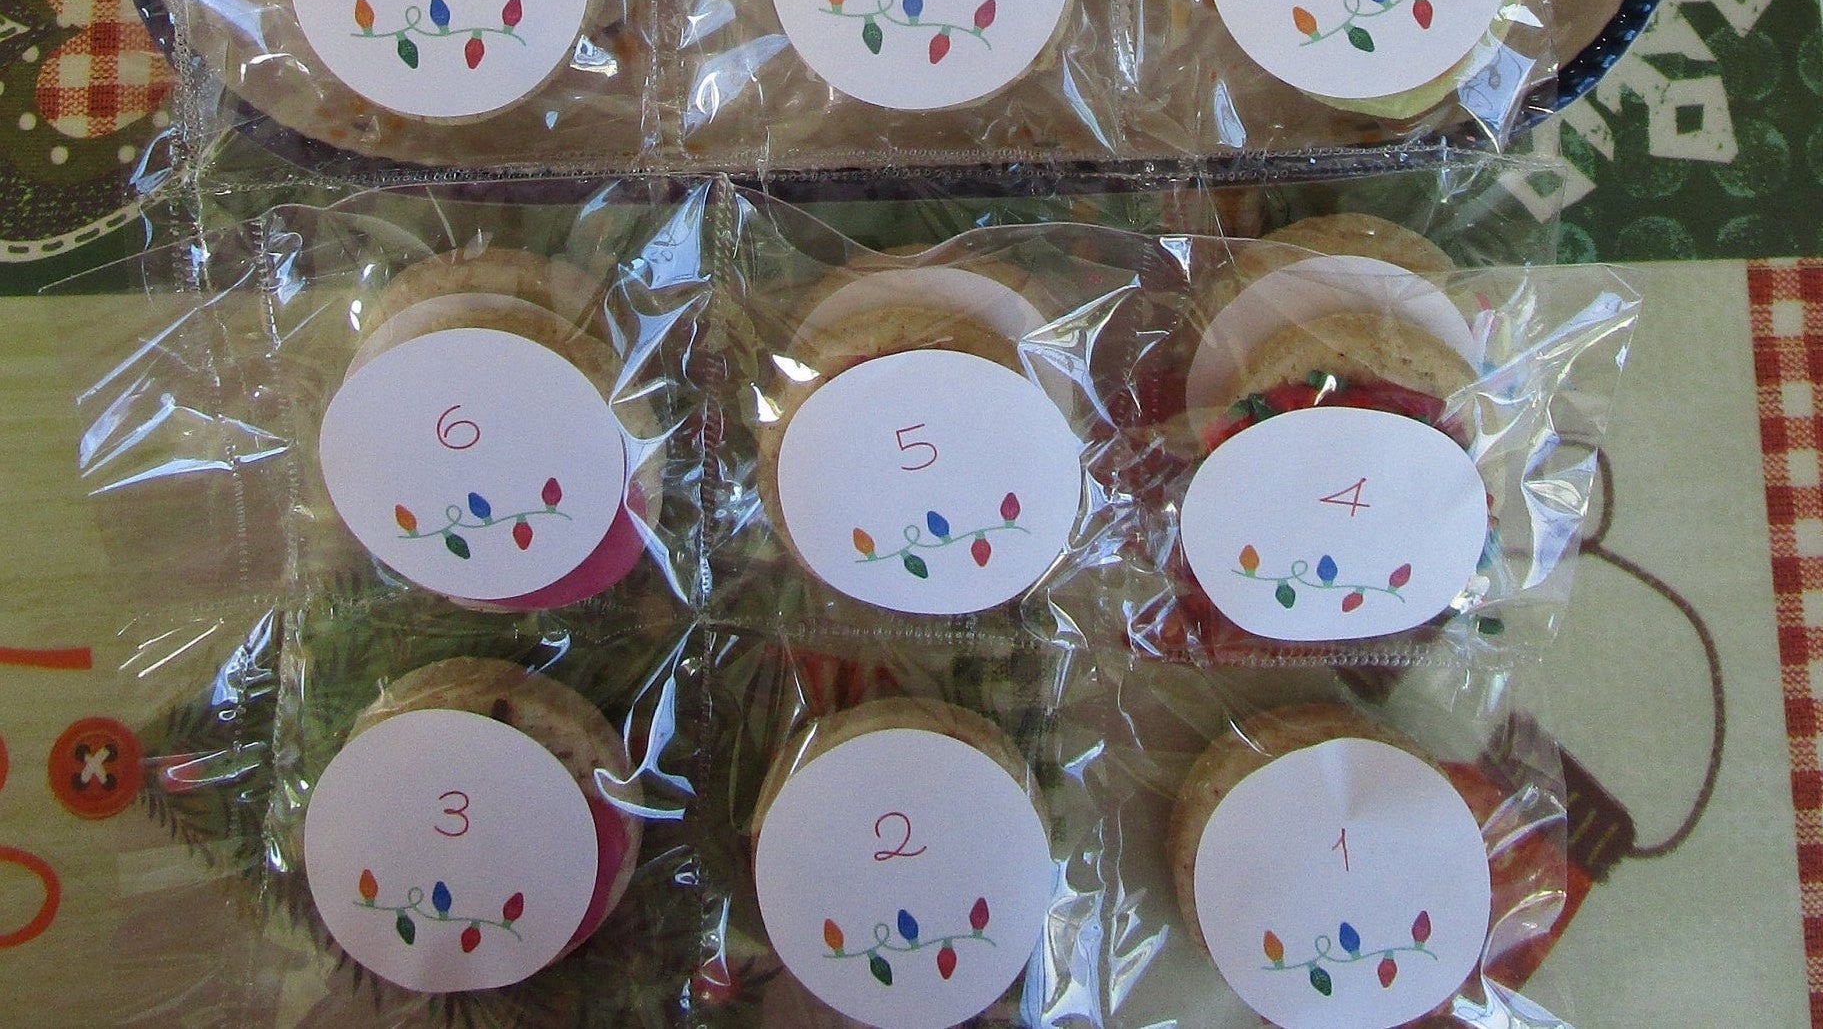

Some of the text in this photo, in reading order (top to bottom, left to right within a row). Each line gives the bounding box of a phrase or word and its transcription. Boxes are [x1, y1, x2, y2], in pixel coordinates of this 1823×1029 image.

[436, 405, 481, 450] 6
[896, 423, 938, 471] 5
[1318, 477, 1370, 517] 4
[434, 790, 469, 838] 3
[874, 811, 927, 861] 2
[1332, 828, 1349, 872] 1
